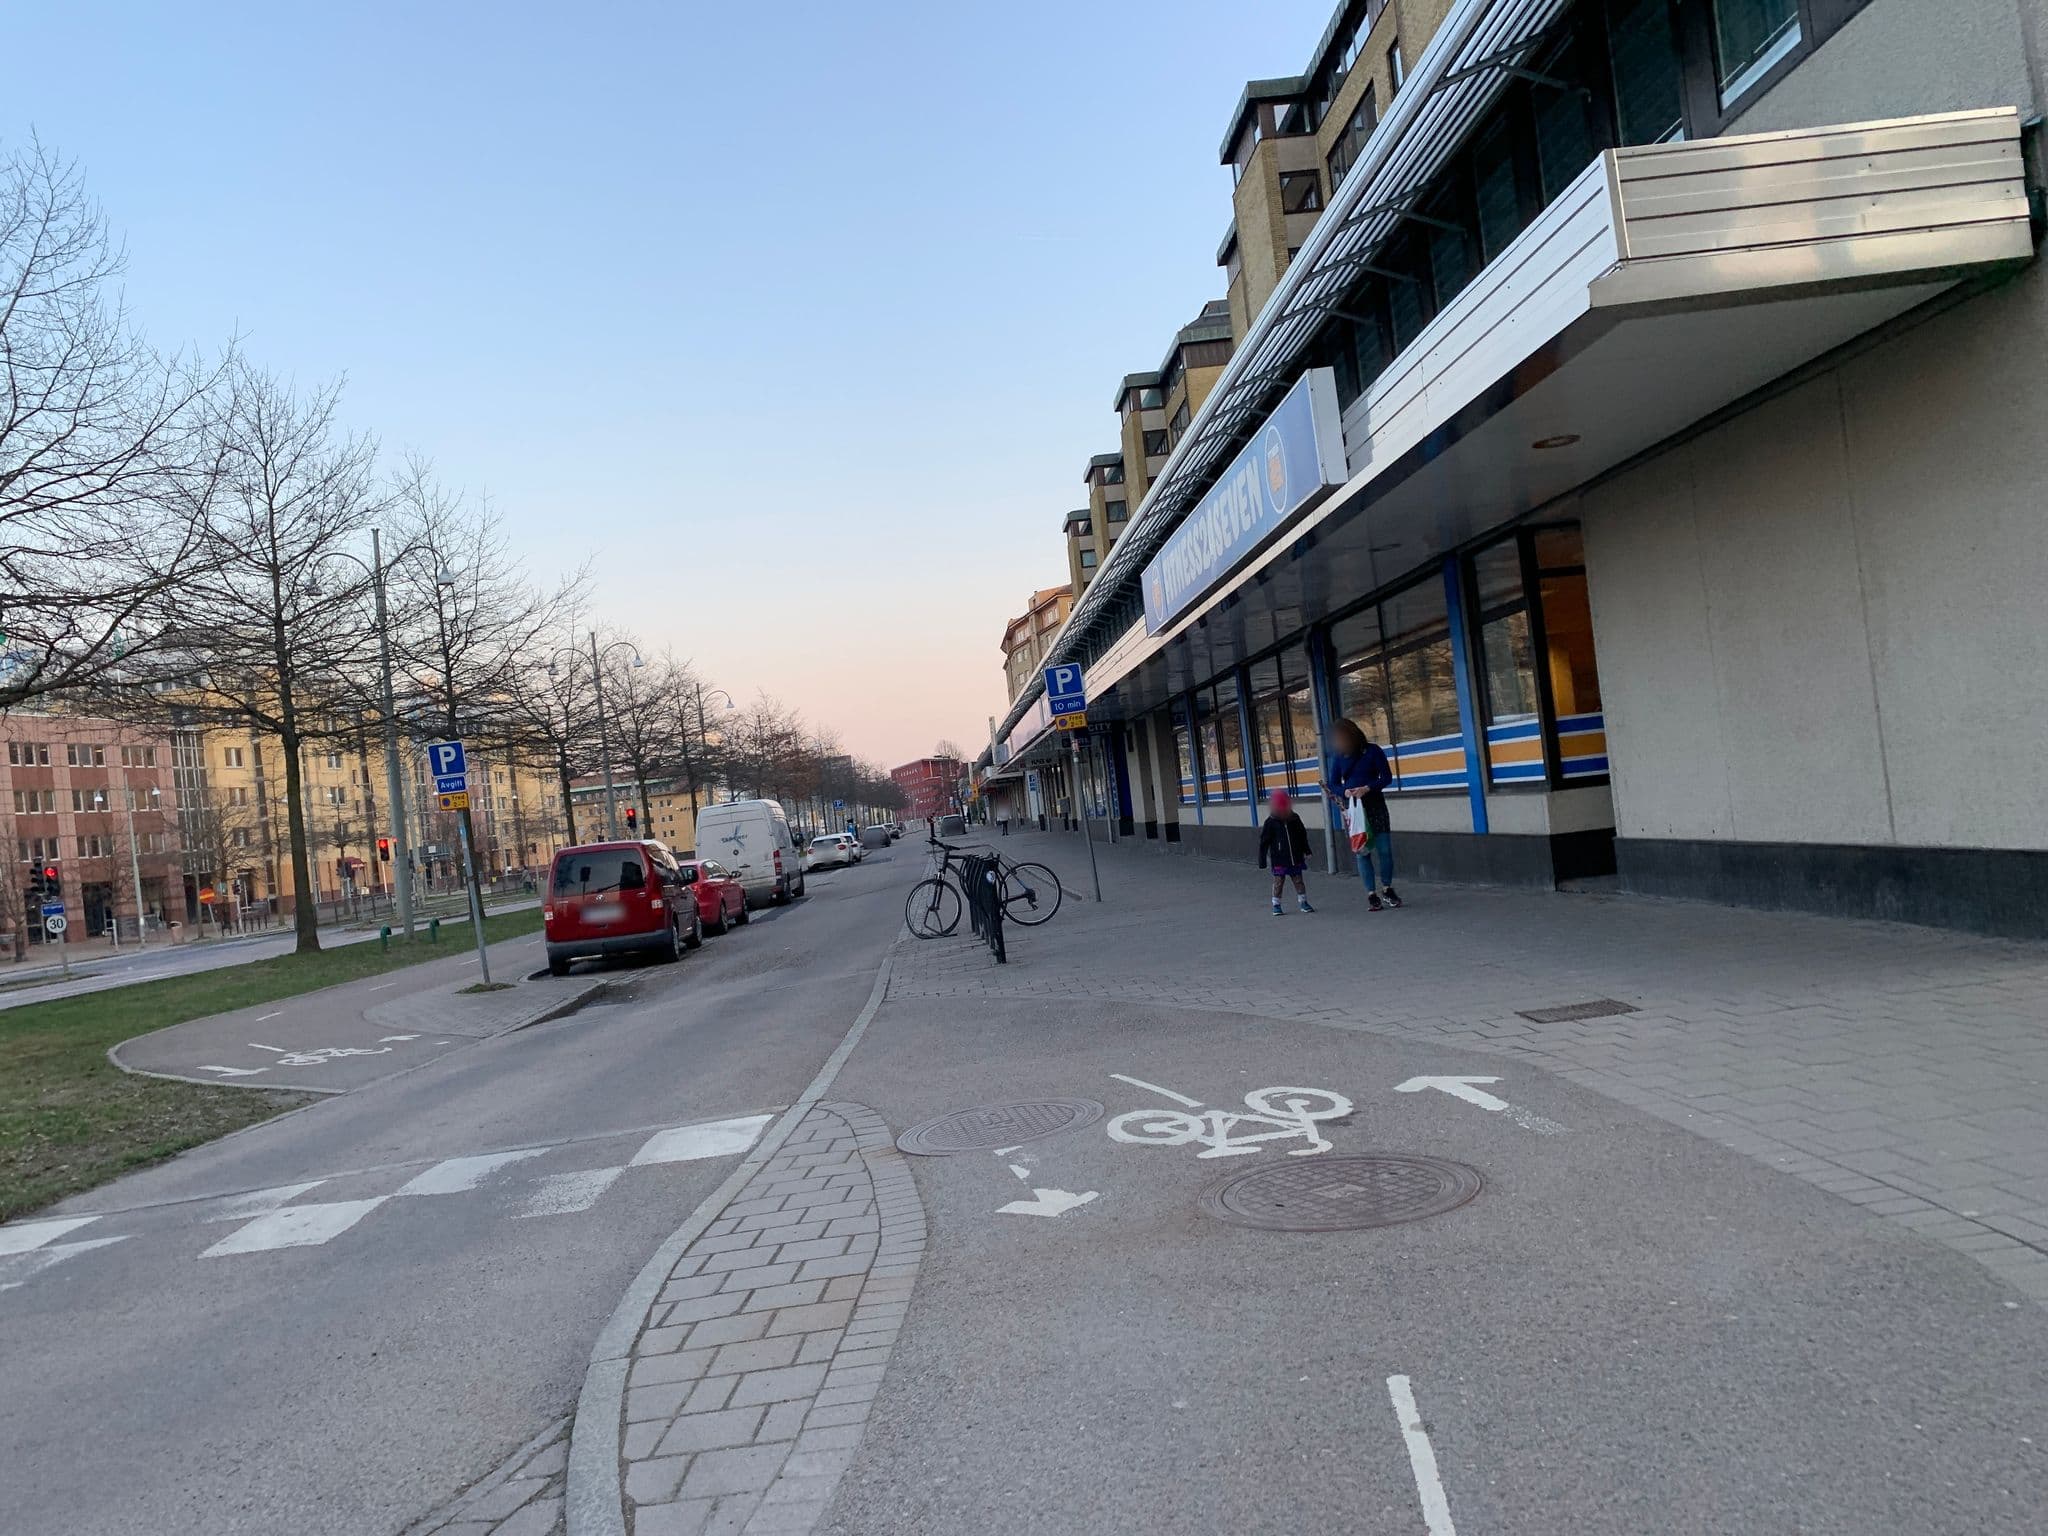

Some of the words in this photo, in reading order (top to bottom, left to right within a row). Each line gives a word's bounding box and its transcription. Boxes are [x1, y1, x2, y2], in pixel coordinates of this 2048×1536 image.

[1055, 668, 1073, 693] P
[1054, 703, 1064, 711] 10
[1067, 701, 1081, 709] min
[1088, 722, 1111, 731] CITY
[438, 746, 456, 773] P
[440, 780, 463, 790] Avgift
[49, 918, 64, 930] 30
